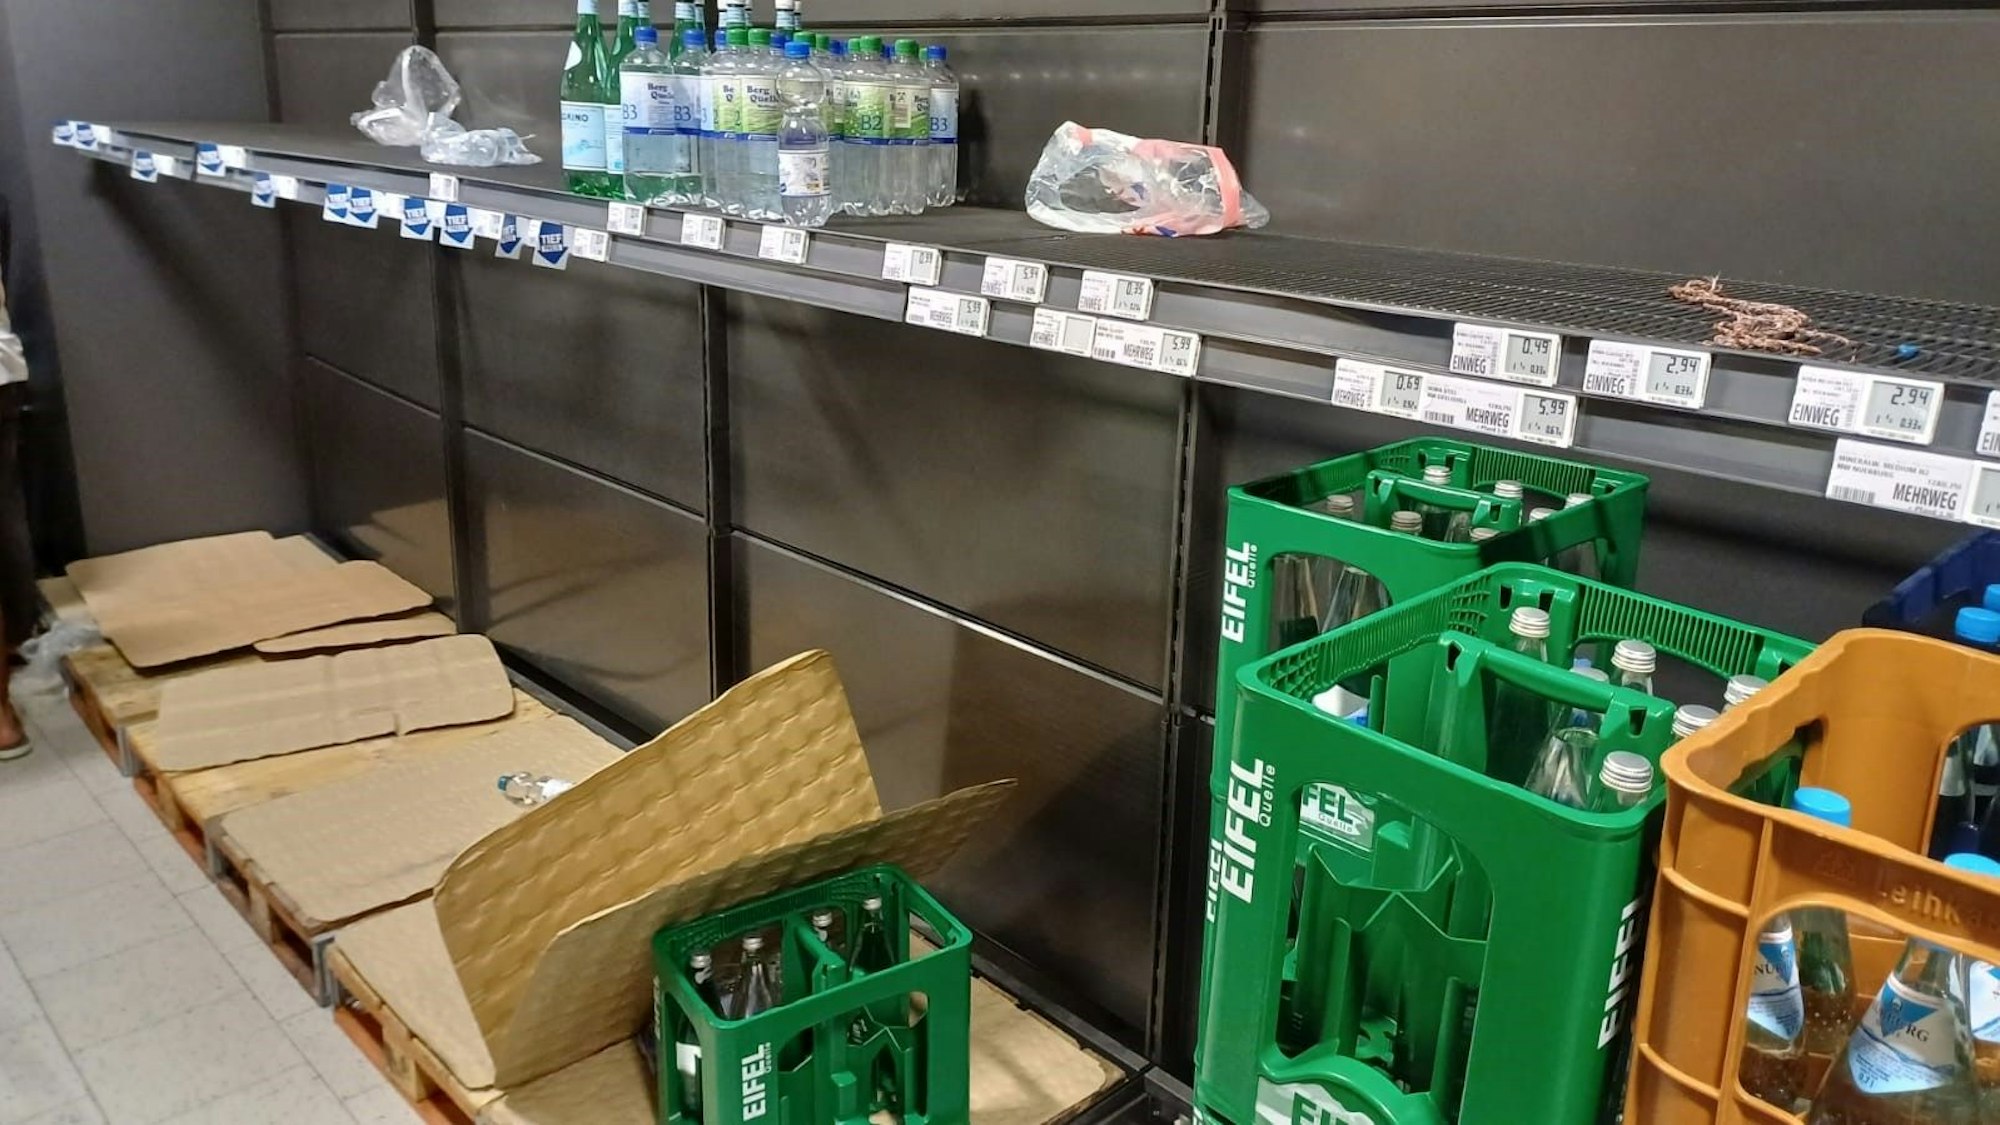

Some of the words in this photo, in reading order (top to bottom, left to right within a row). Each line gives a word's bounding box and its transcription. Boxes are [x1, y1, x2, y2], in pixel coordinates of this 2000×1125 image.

[674, 105, 691, 121] B3
[861, 115, 883, 131] B2
[930, 117, 948, 132] B3
[540, 233, 563, 245] TIEF
[1171, 336, 1192, 351] 5.99
[1522, 338, 1549, 356] 0.49
[1452, 354, 1487, 375] EINWEG
[1666, 356, 1698, 375] 2.94
[1396, 374, 1420, 391] 0.69
[1585, 373, 1626, 395] EINWEG
[1891, 386, 1929, 406] 2.94
[1465, 406, 1510, 428] MEHRWEG
[1538, 398, 1565, 417] 5.99
[1792, 403, 1840, 427] EINWEG
[1892, 482, 1958, 511] MEHRWEG
[1222, 541, 1250, 644] EIFEL
[1258, 764, 1276, 827] Quelle
[1220, 758, 1264, 904] EIFEL
[741, 1043, 767, 1122] EIFEL
